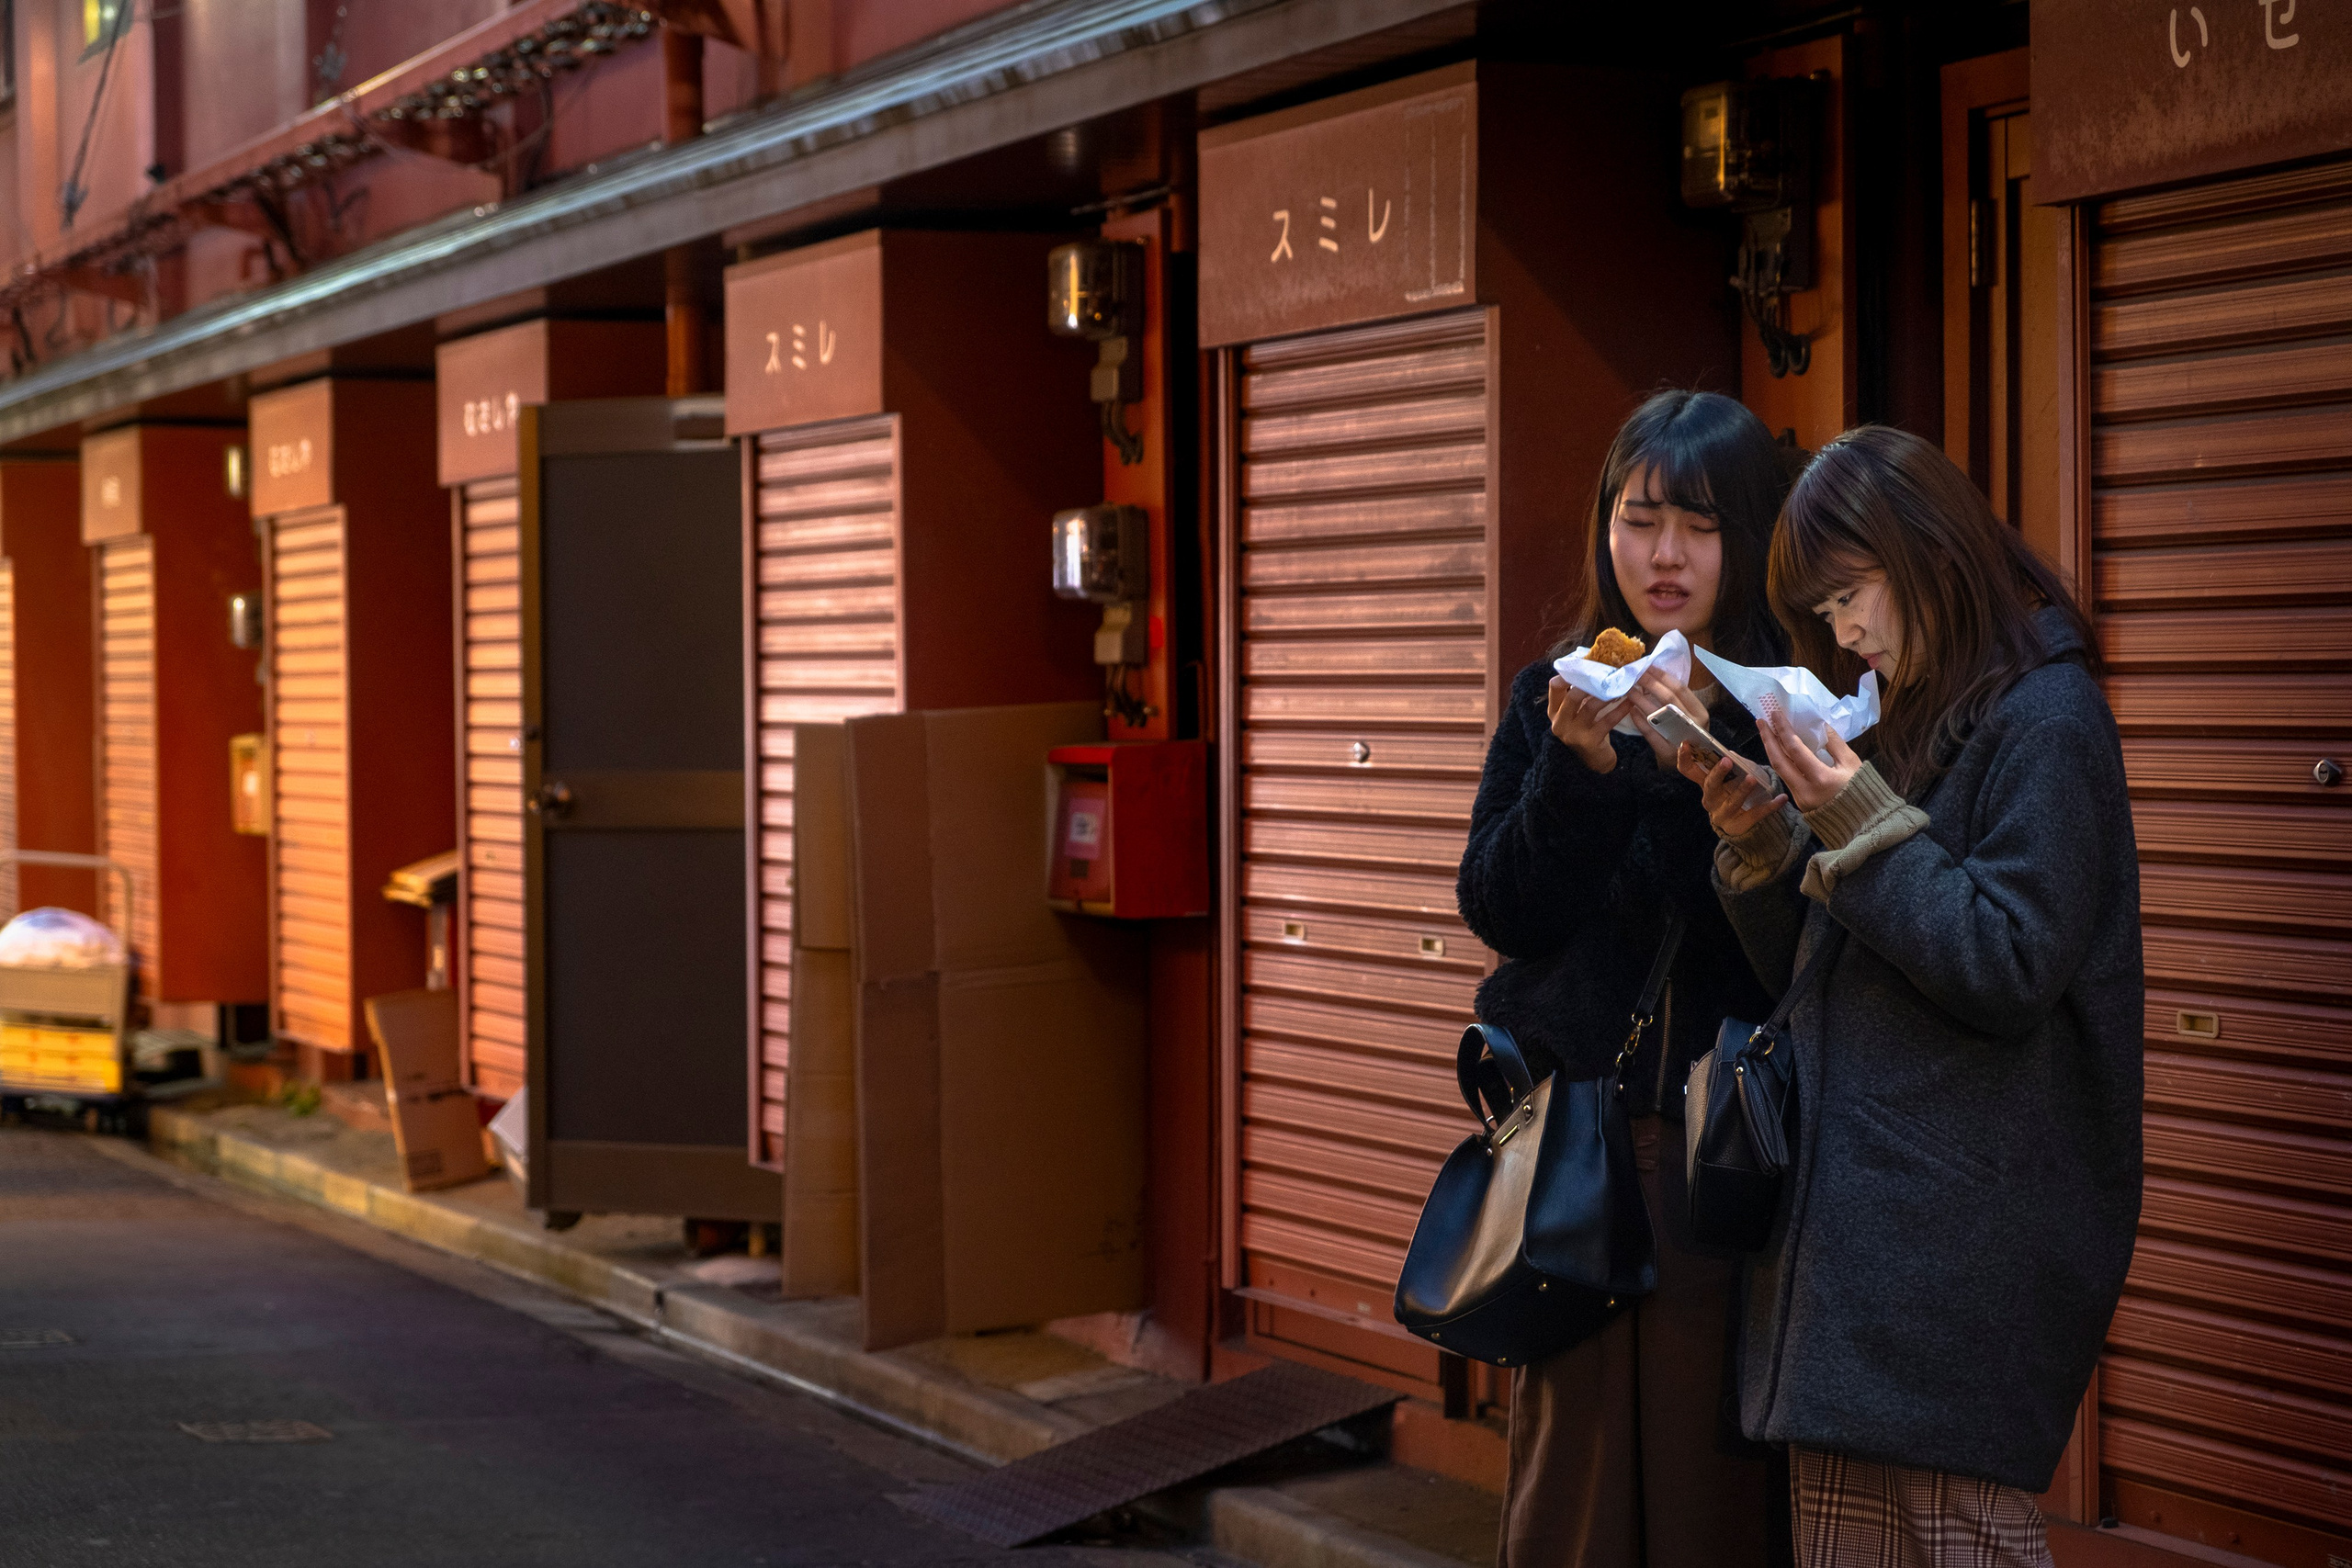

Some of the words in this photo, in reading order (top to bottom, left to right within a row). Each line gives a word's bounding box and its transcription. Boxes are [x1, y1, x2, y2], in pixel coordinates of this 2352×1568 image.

[1271, 186, 1391, 263] スミレ
[764, 320, 837, 375] スミレ
